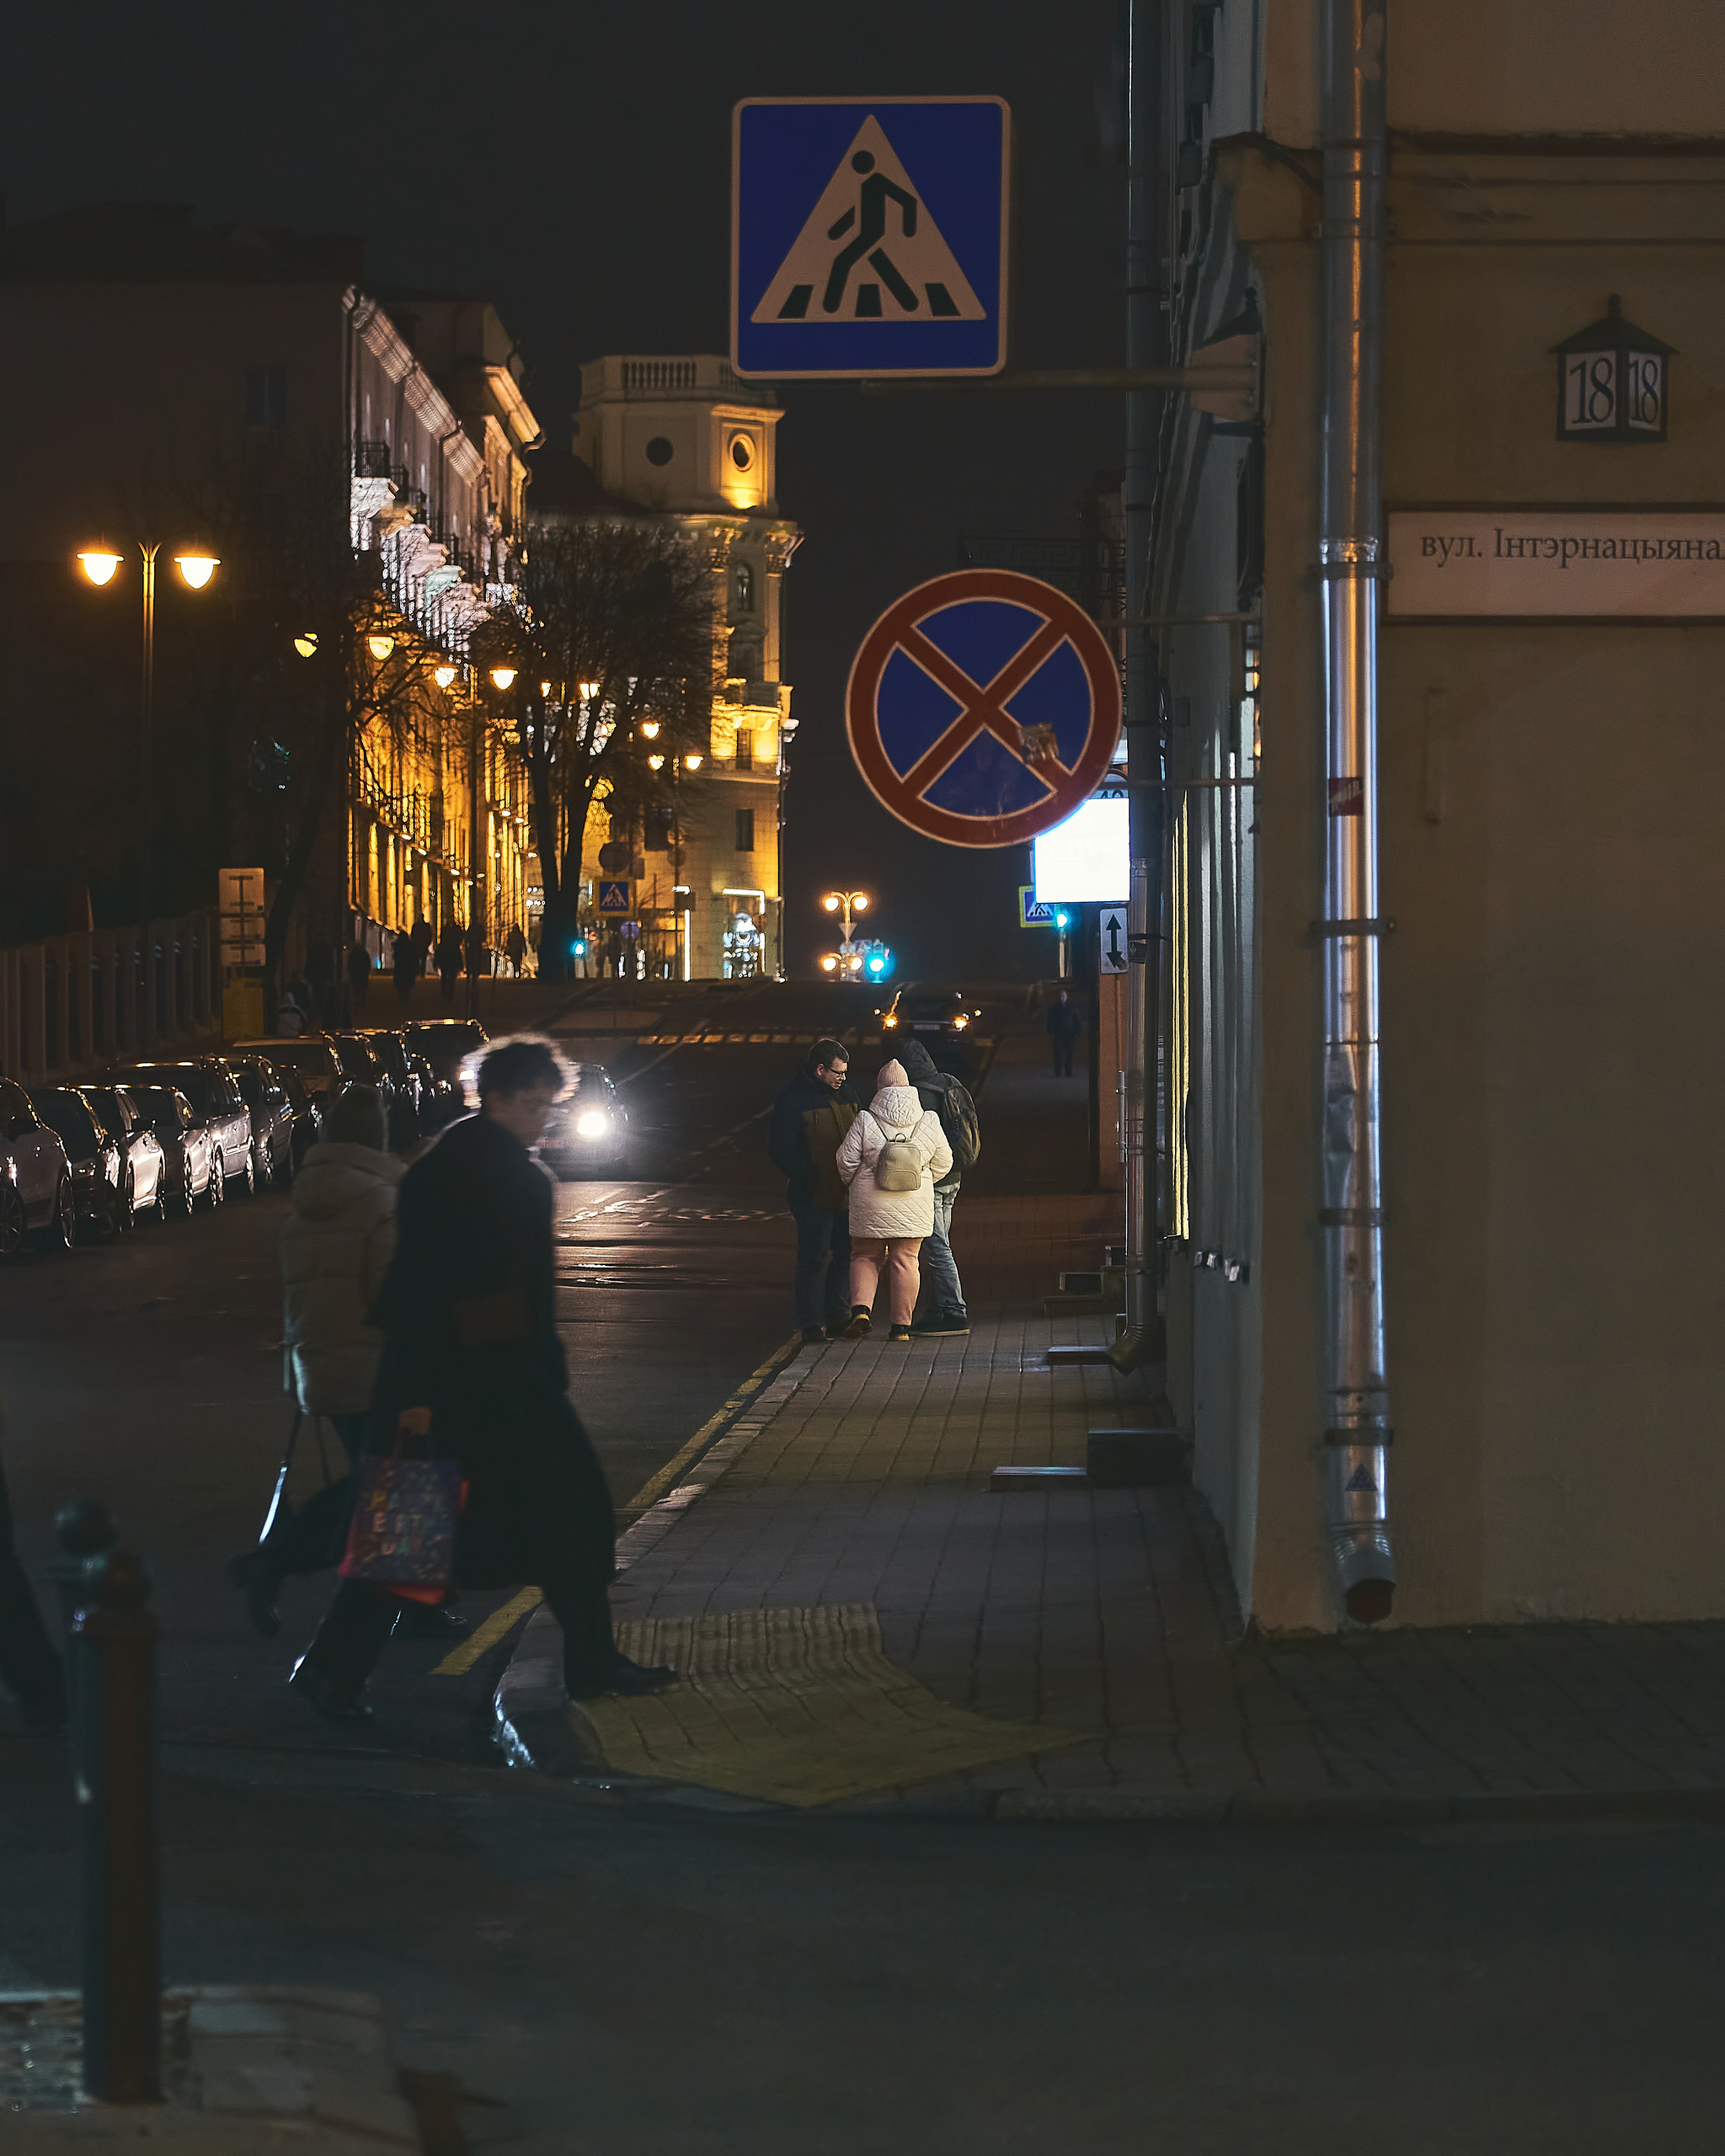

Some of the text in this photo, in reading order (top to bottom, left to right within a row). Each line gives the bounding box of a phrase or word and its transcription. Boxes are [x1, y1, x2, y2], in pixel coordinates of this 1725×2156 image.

[1570, 357, 1615, 424] 18
[1629, 359, 1659, 424] 18
[1421, 528, 1725, 569] вул. Інтэрнацыяна
